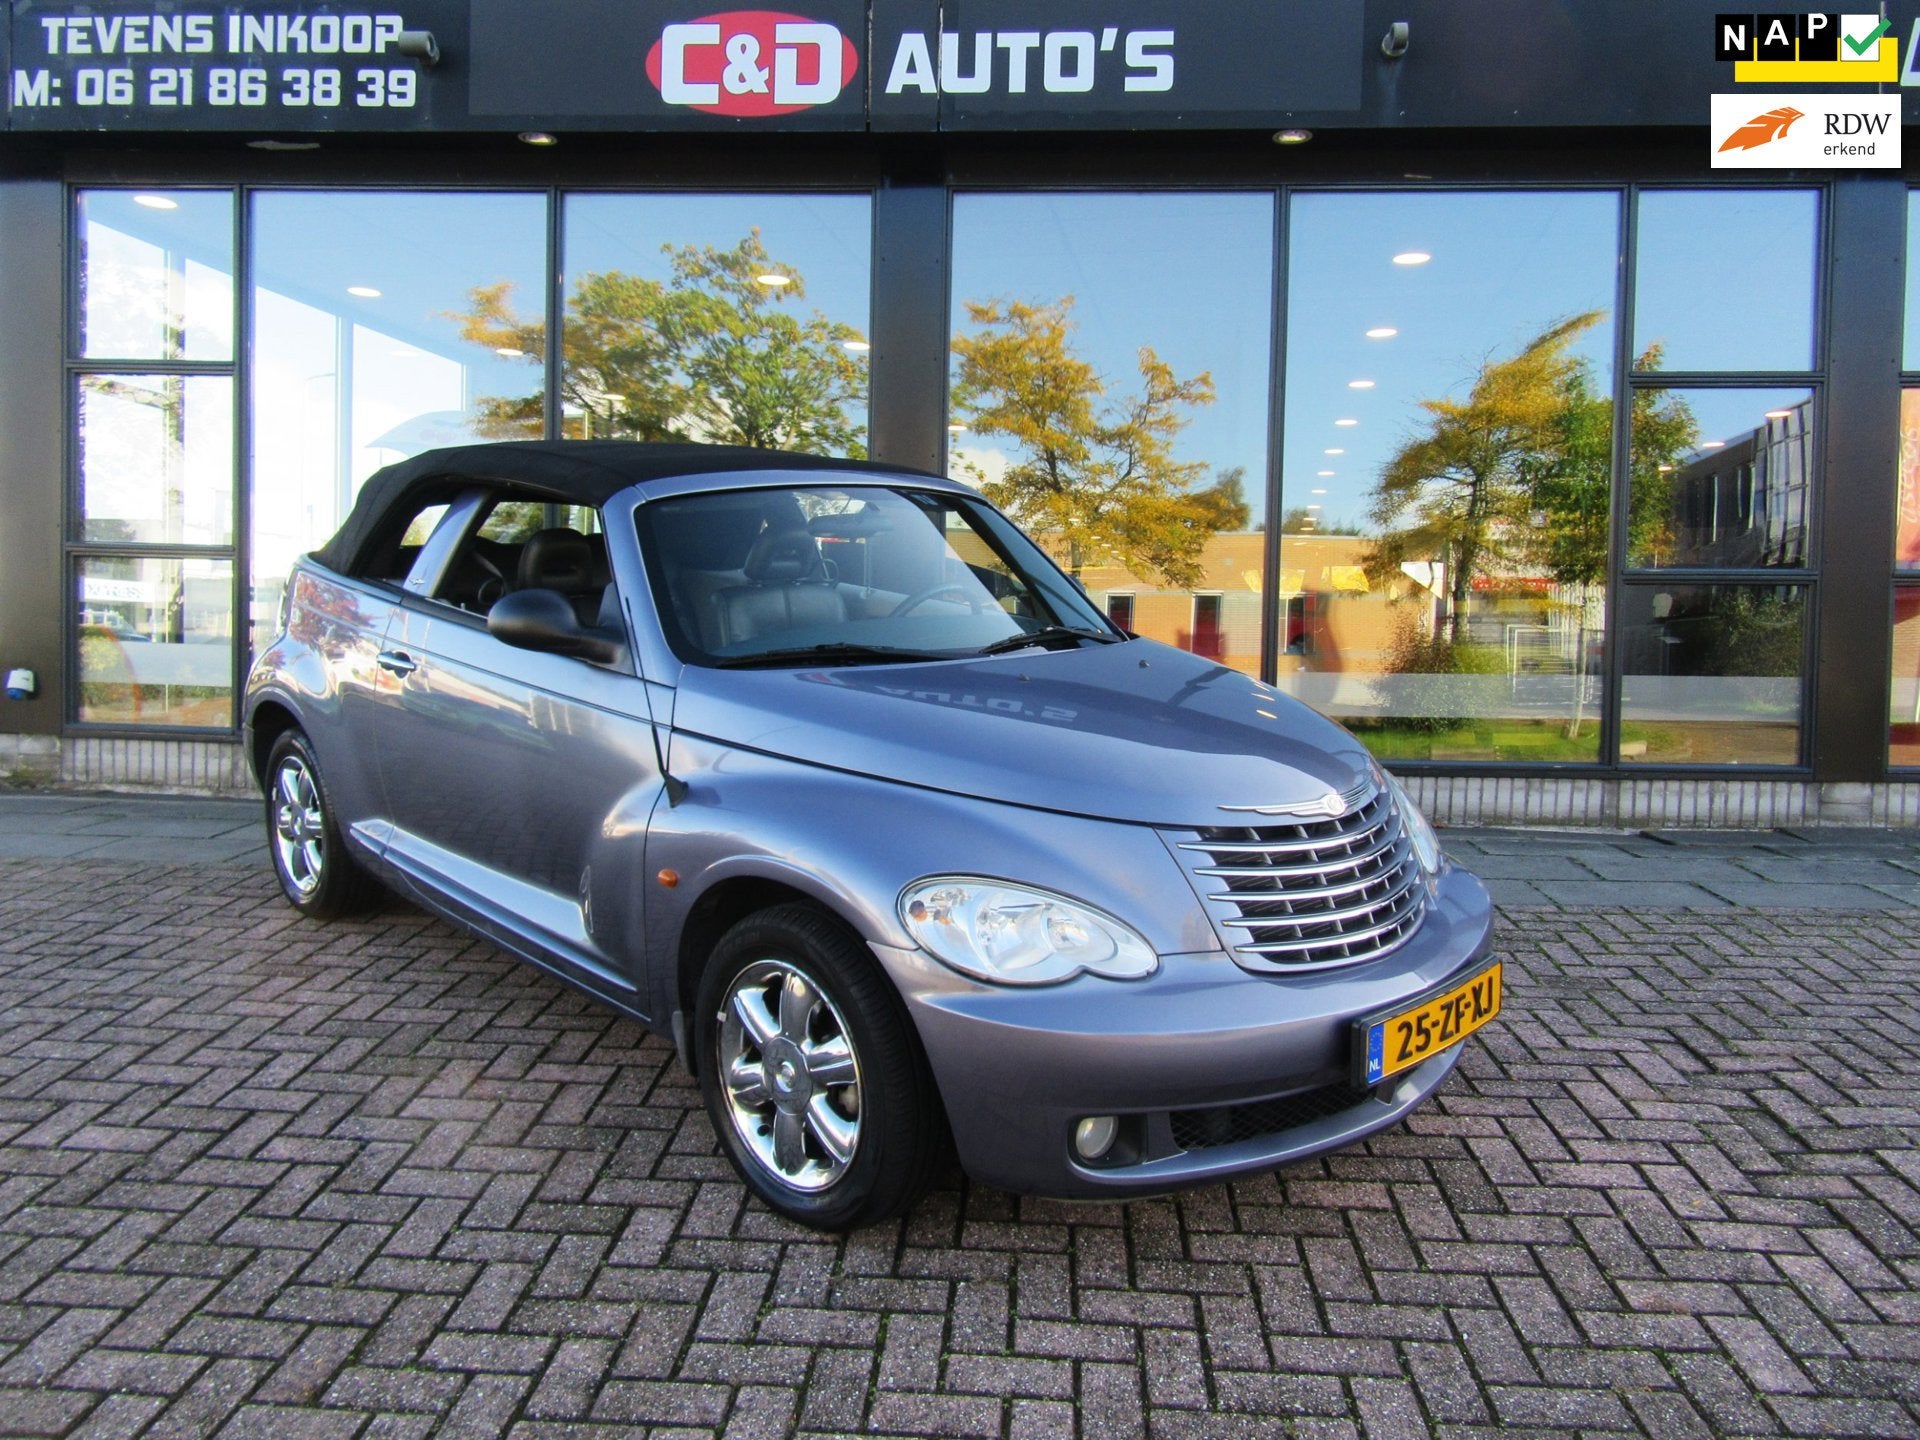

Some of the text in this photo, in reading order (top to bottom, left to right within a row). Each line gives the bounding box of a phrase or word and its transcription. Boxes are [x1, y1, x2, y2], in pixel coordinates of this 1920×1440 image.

[41, 15, 404, 54] TEVENS INKOOP
[660, 23, 843, 105] C&D
[885, 28, 1175, 94] AUTO'S
[14, 69, 417, 107] M: 06 21 86 38 39
[1395, 975, 1494, 1063] 25-ZF-XJ
[1368, 1058, 1381, 1073] NL
